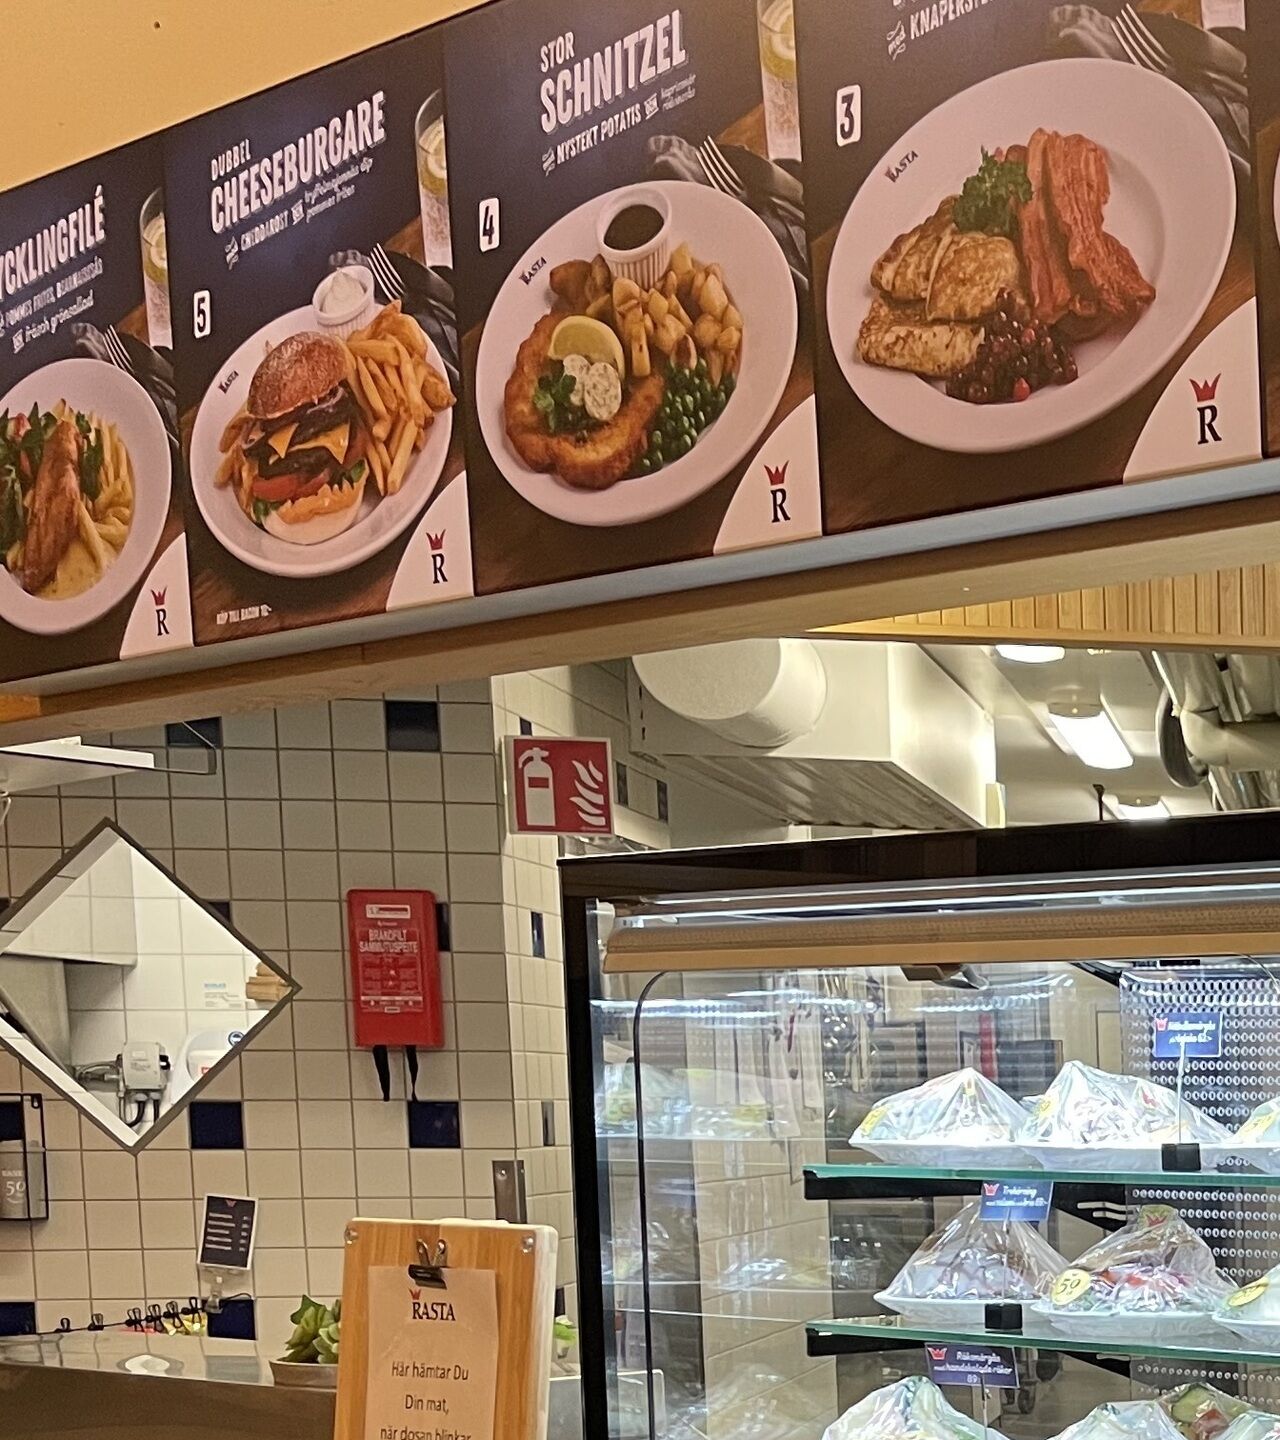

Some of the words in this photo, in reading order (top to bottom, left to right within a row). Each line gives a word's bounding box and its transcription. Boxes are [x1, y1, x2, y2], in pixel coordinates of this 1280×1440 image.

[541, 32, 574, 73] STOR
[541, 9, 688, 133] SCHNITZEL
[556, 125, 598, 165] NYSTEKT
[601, 103, 642, 141] POTATIS
[840, 93, 855, 142] 3
[211, 138, 251, 181] DUBBEL
[211, 90, 386, 234] CHEESEBURGARE
[197, 297, 207, 334] 5
[1197, 406, 1221, 445] R
[770, 488, 791, 524] R
[431, 552, 447, 584] R
[412, 1302, 456, 1321] RASTA
[392, 1361, 409, 1379] Här
[412, 1364, 451, 1380] hämtar
[453, 1365, 469, 1381] Du
[405, 1394, 423, 1410] Din
[426, 1398, 449, 1415] mat,
[380, 1426, 398, 1440] när
